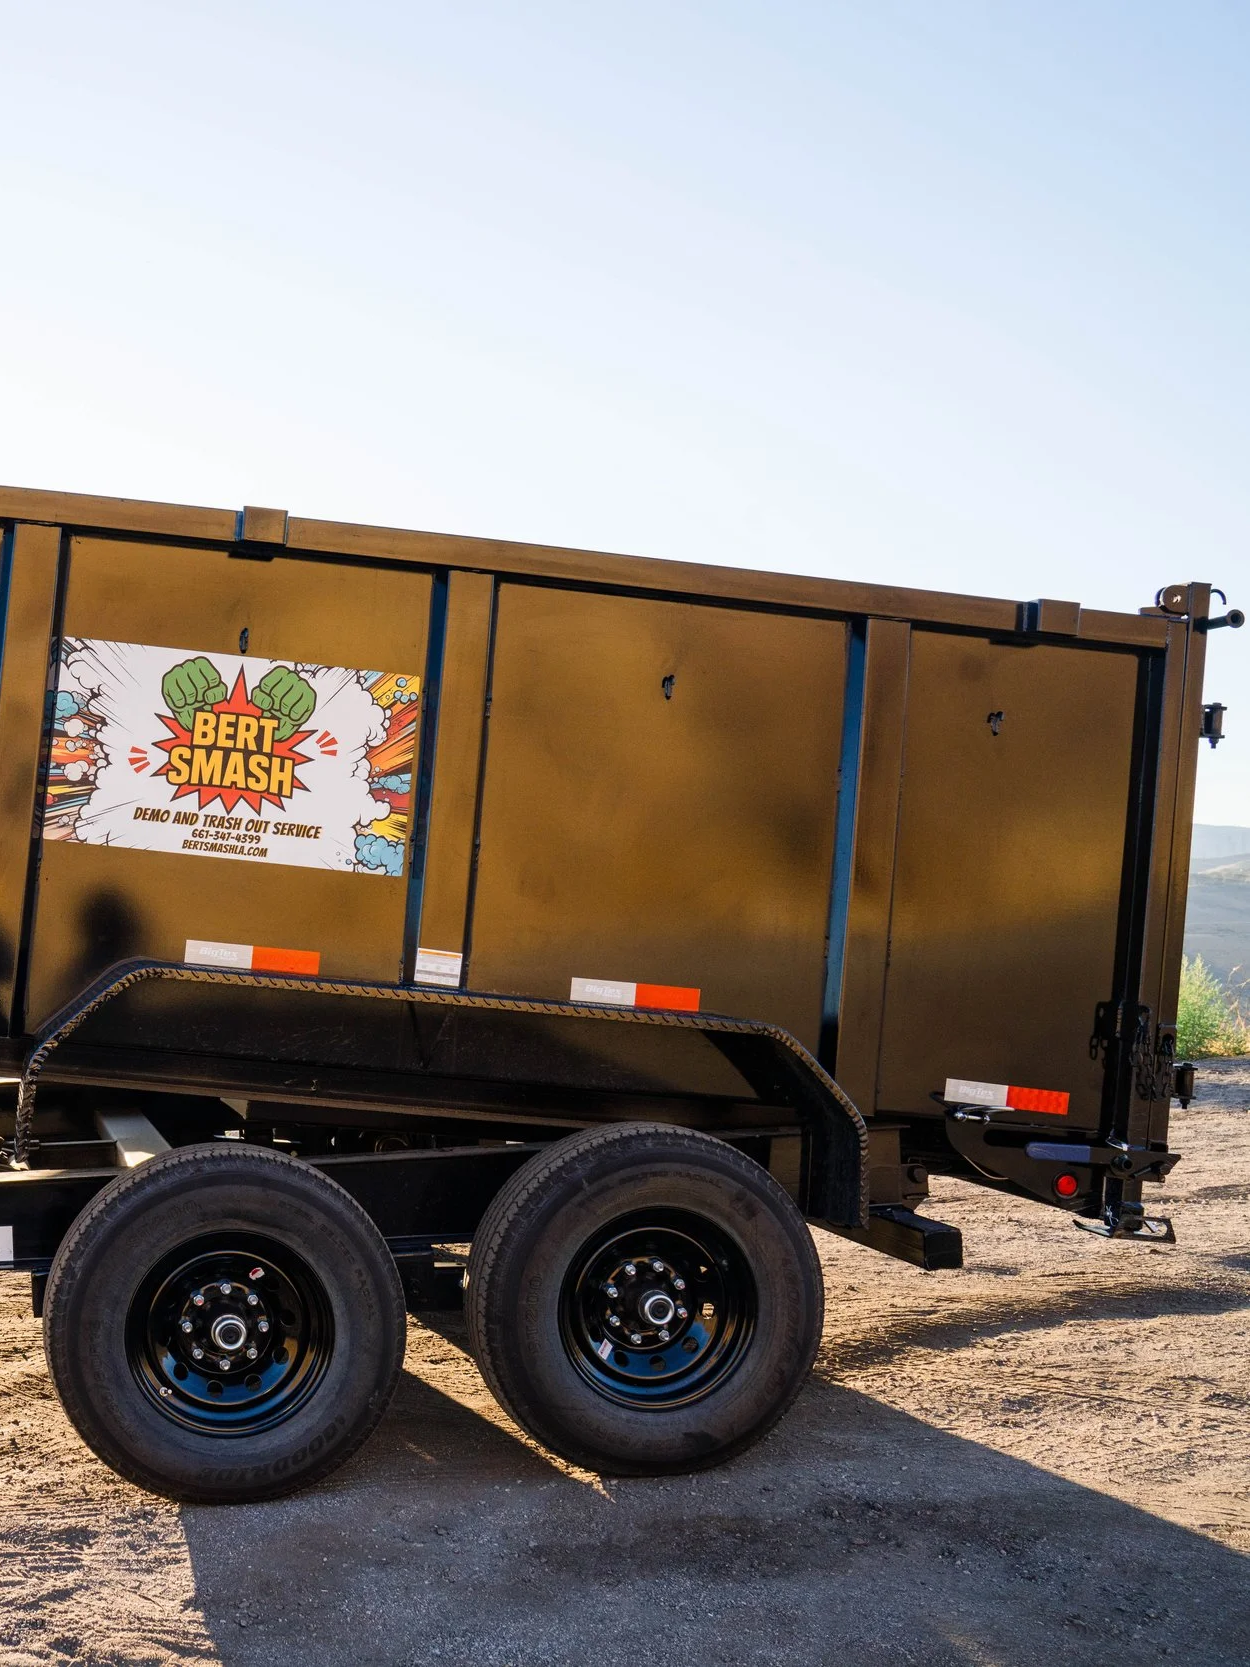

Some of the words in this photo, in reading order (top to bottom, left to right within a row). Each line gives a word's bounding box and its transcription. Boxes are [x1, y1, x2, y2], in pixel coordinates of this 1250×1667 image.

[191, 711, 280, 754] BERT
[166, 745, 296, 799] SMASH
[133, 806, 171, 823] DEMO
[171, 810, 199, 826] AND
[202, 814, 243, 831] TRASH
[244, 818, 271, 834] OUT
[271, 821, 323, 839] SERVICE
[191, 828, 261, 844] 661-347-4399
[181, 839, 269, 858] BERTSMASHLA.COM
